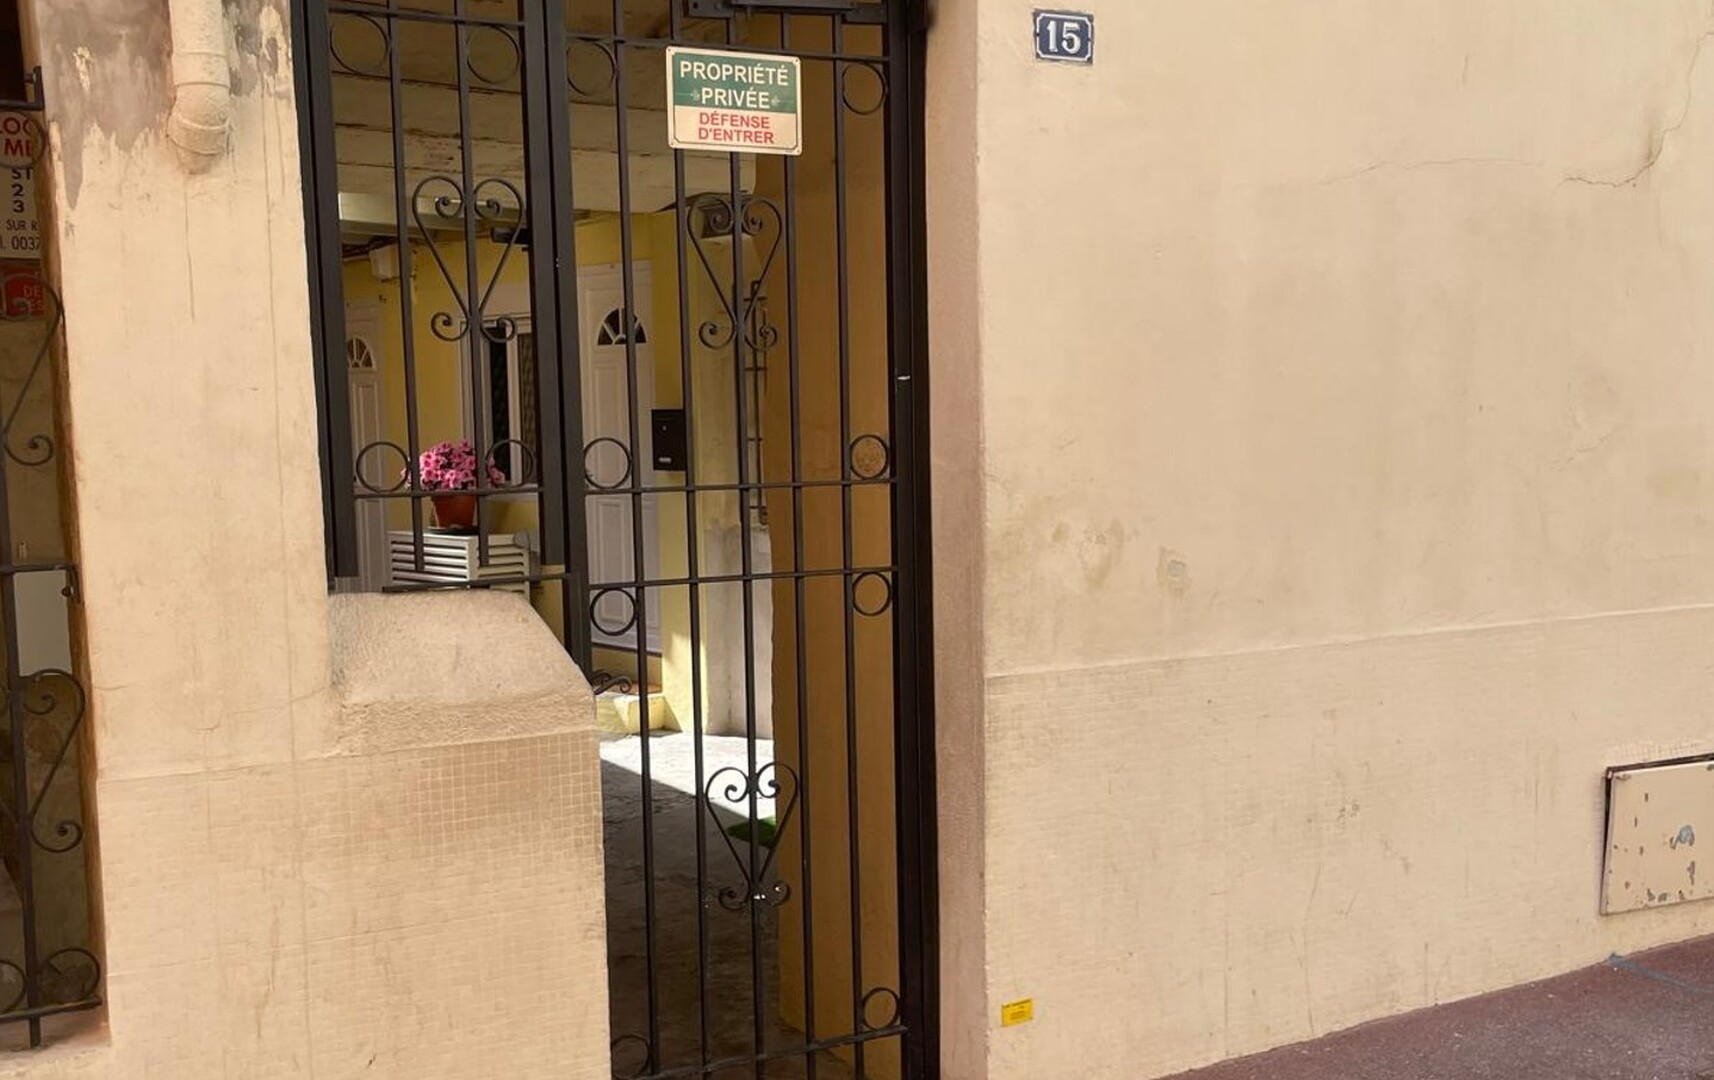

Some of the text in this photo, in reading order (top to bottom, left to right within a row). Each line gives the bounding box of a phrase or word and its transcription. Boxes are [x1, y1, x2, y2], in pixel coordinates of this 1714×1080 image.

[1046, 20, 1081, 54] 15
[680, 60, 789, 87] PROPRIÉTÉ
[701, 87, 771, 110] PRIVÉE
[0, 116, 32, 136] OC
[699, 111, 771, 129] DÉFENSE
[698, 127, 775, 144] D'ENTRER
[11, 183, 25, 197] 2
[12, 199, 25, 213] 3
